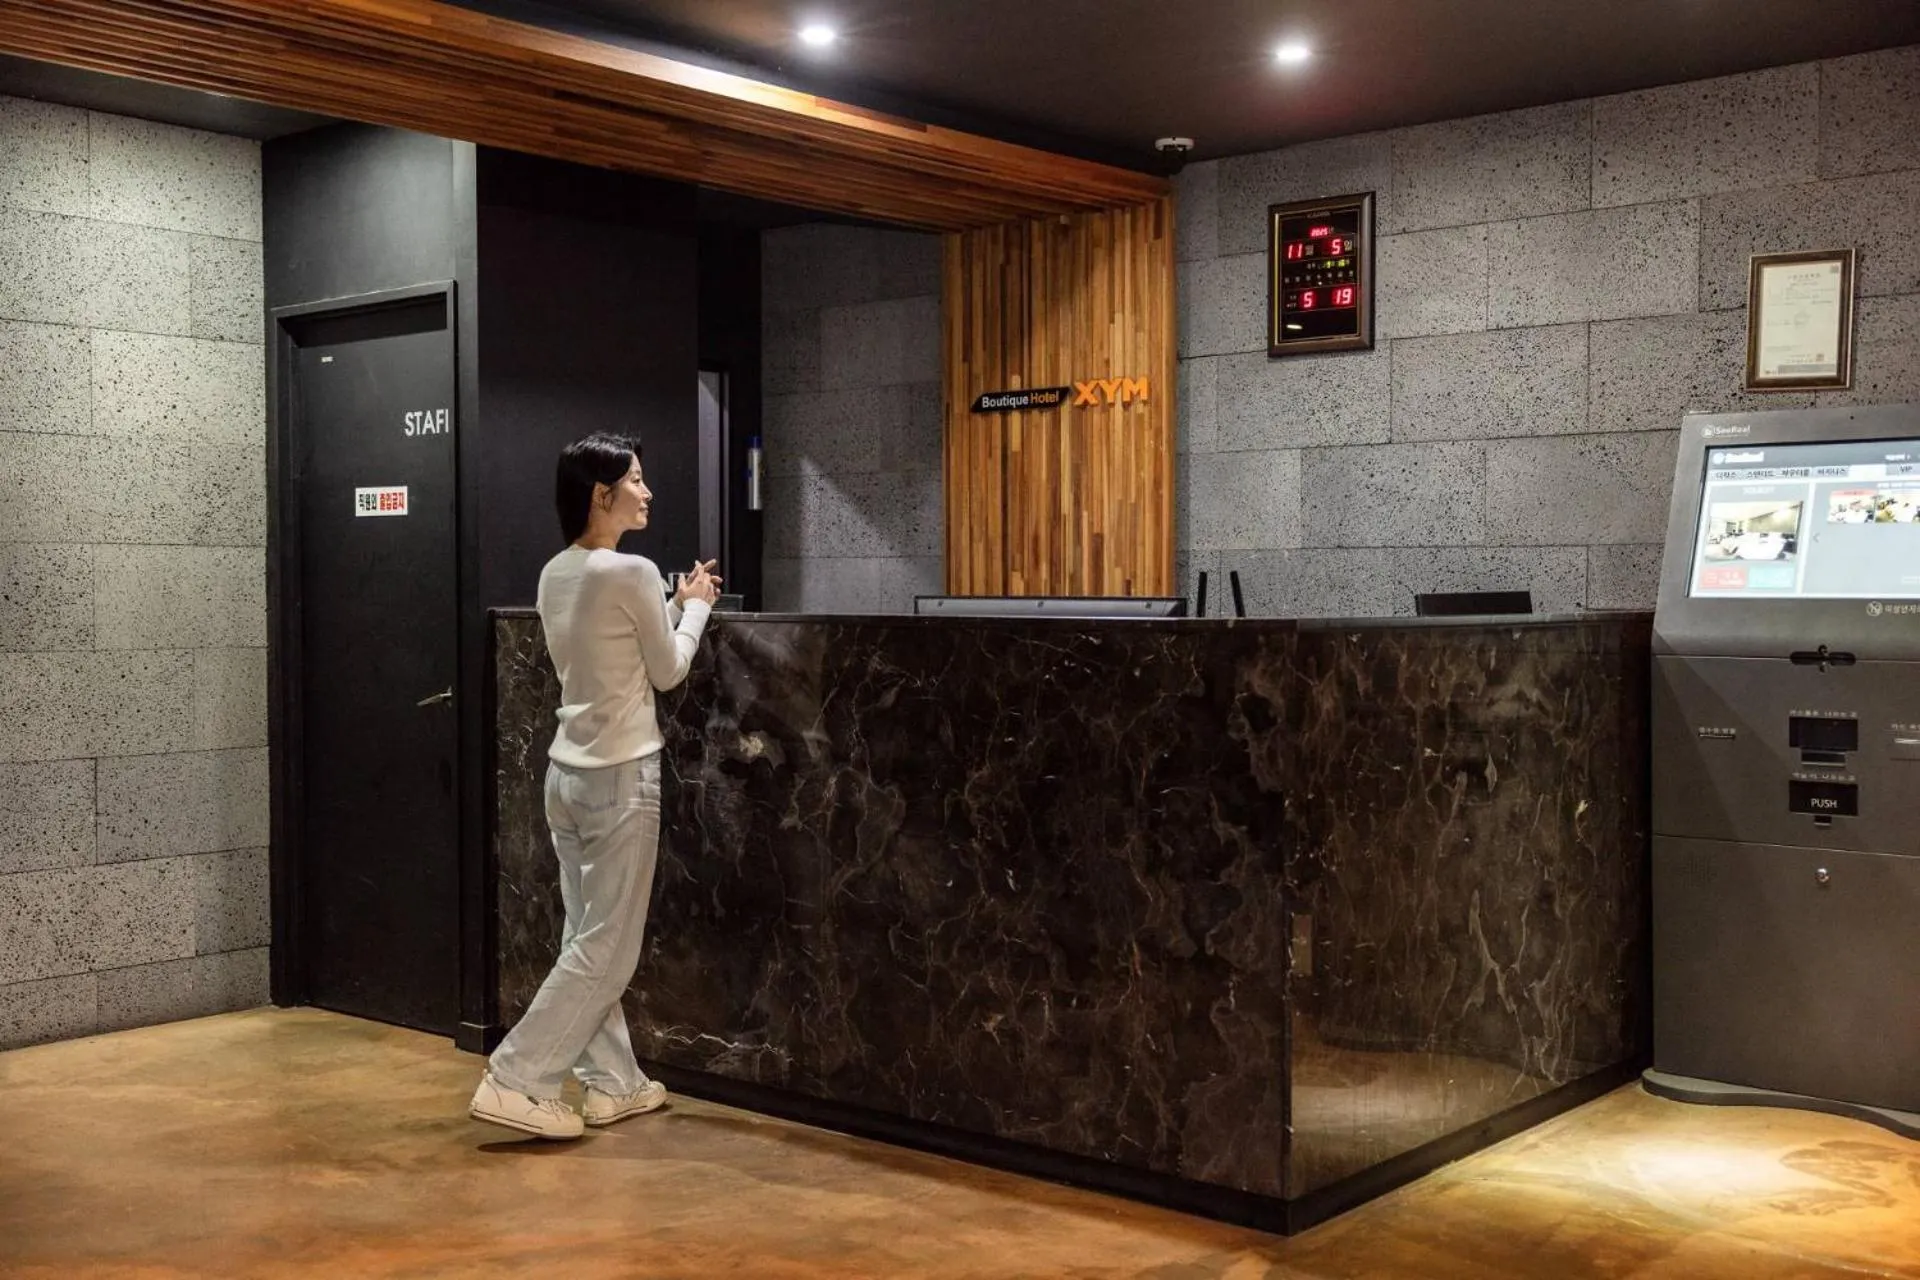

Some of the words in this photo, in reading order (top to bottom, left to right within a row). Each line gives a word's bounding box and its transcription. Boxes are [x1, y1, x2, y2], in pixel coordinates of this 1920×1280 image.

[1288, 243, 1303, 259] 11
[1331, 238, 1342, 255] 5
[1303, 291, 1314, 308] 5
[1333, 288, 1352, 305] 19
[981, 395, 1029, 409] Boutique
[1030, 390, 1060, 404] Hotel
[1073, 376, 1148, 407] XYM
[1810, 798, 1838, 808] PUSH
